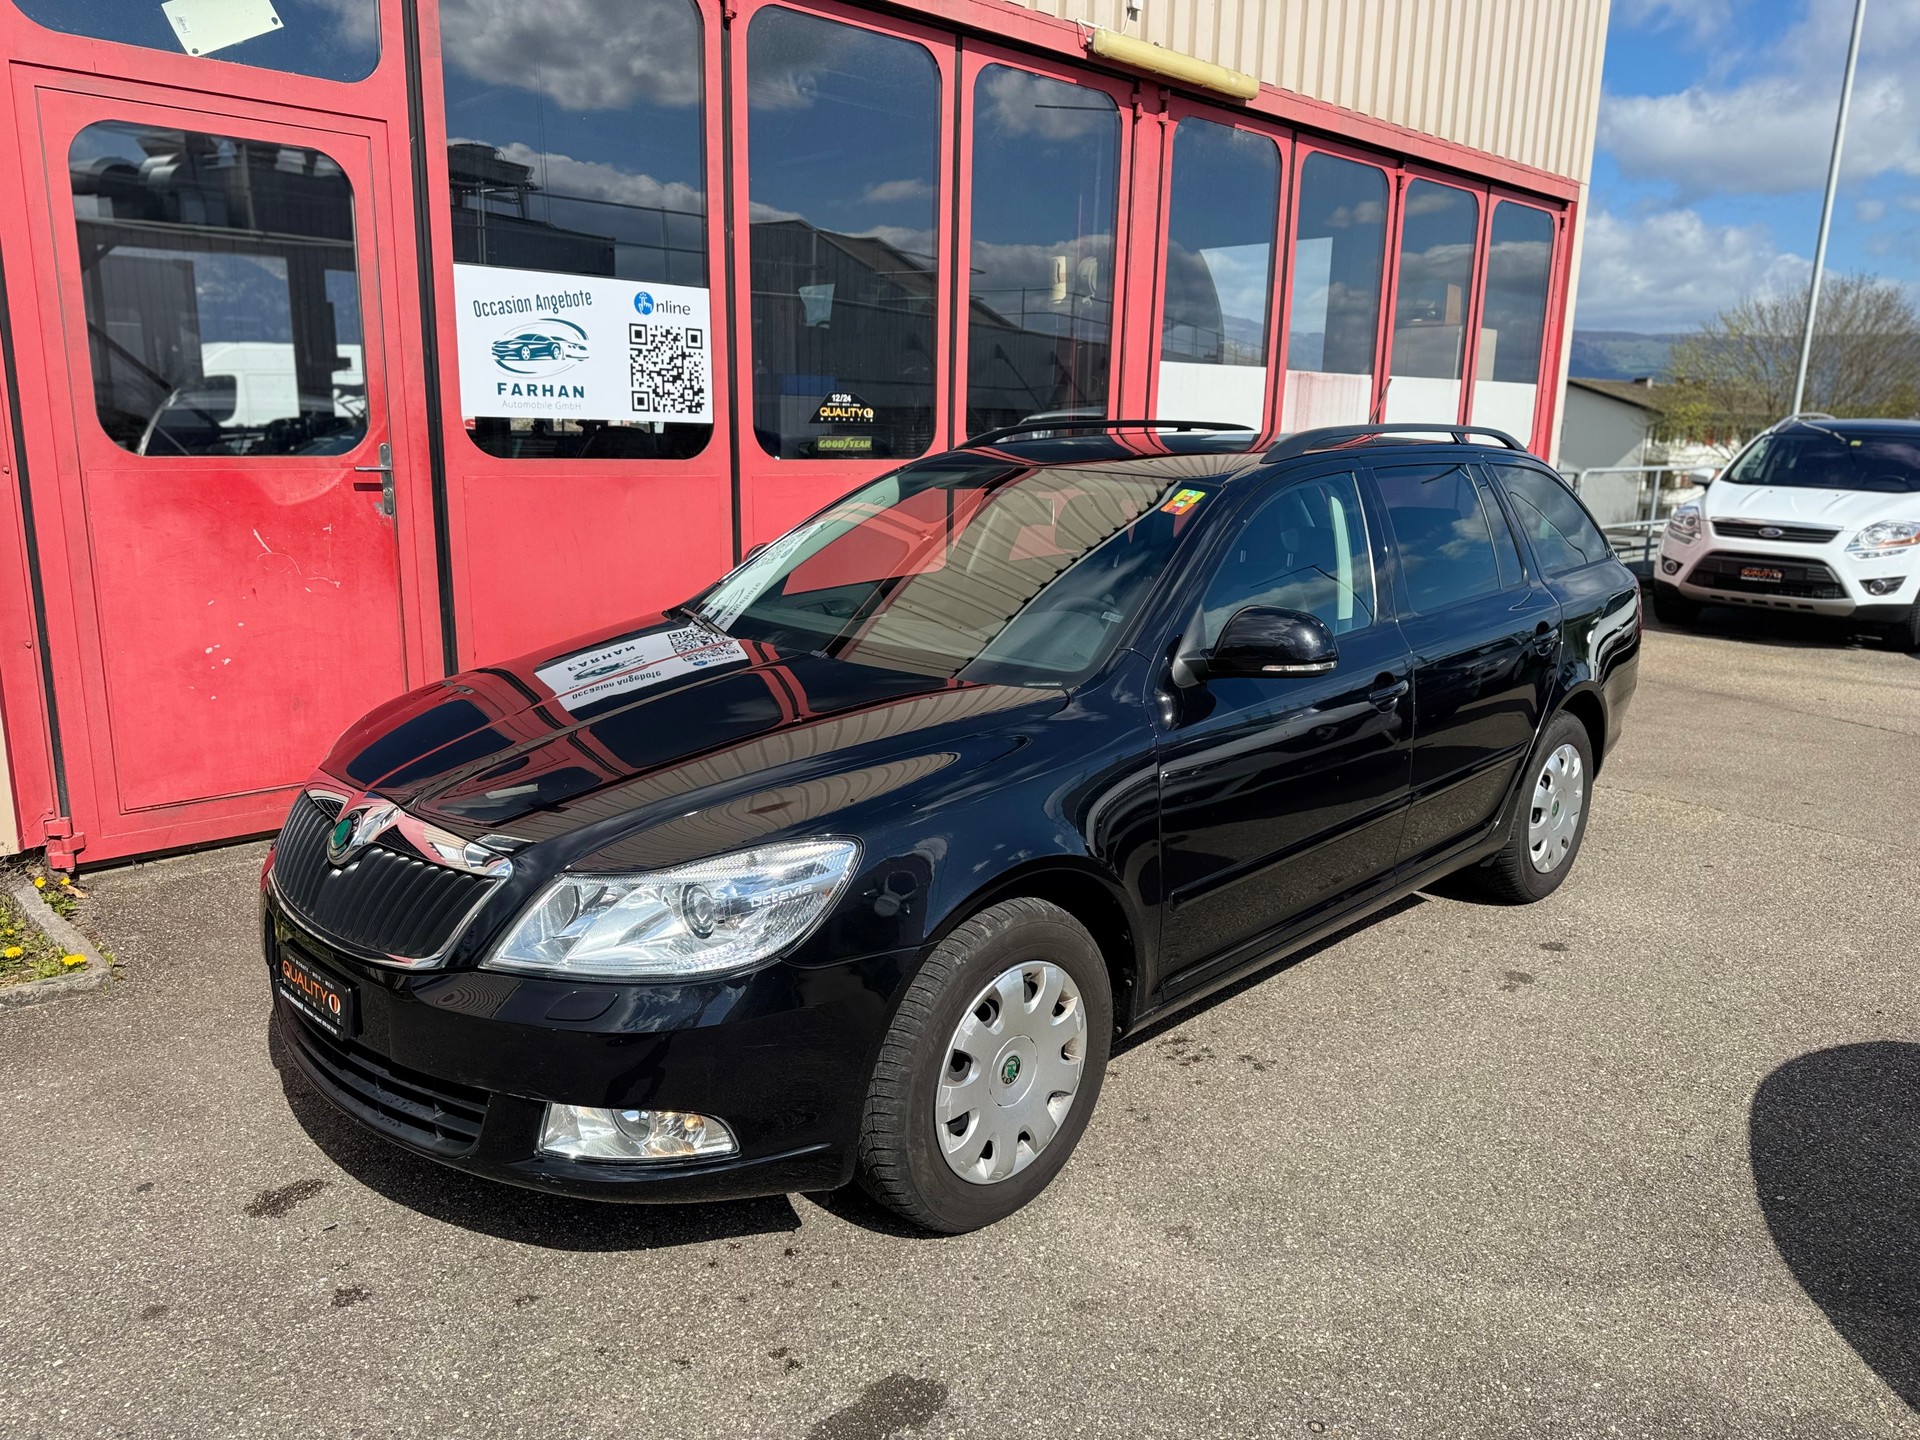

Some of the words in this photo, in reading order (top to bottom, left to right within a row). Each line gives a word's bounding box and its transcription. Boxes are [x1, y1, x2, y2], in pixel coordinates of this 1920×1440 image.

[473, 296, 533, 318] Occasion
[536, 289, 593, 314] Angebote
[497, 382, 585, 399] FARHAN
[832, 394, 852, 402] 12/24
[502, 400, 553, 411] Automobile
[556, 401, 582, 411] GmbH
[750, 883, 813, 908] Octavia
[282, 959, 329, 1005] QUALITY
